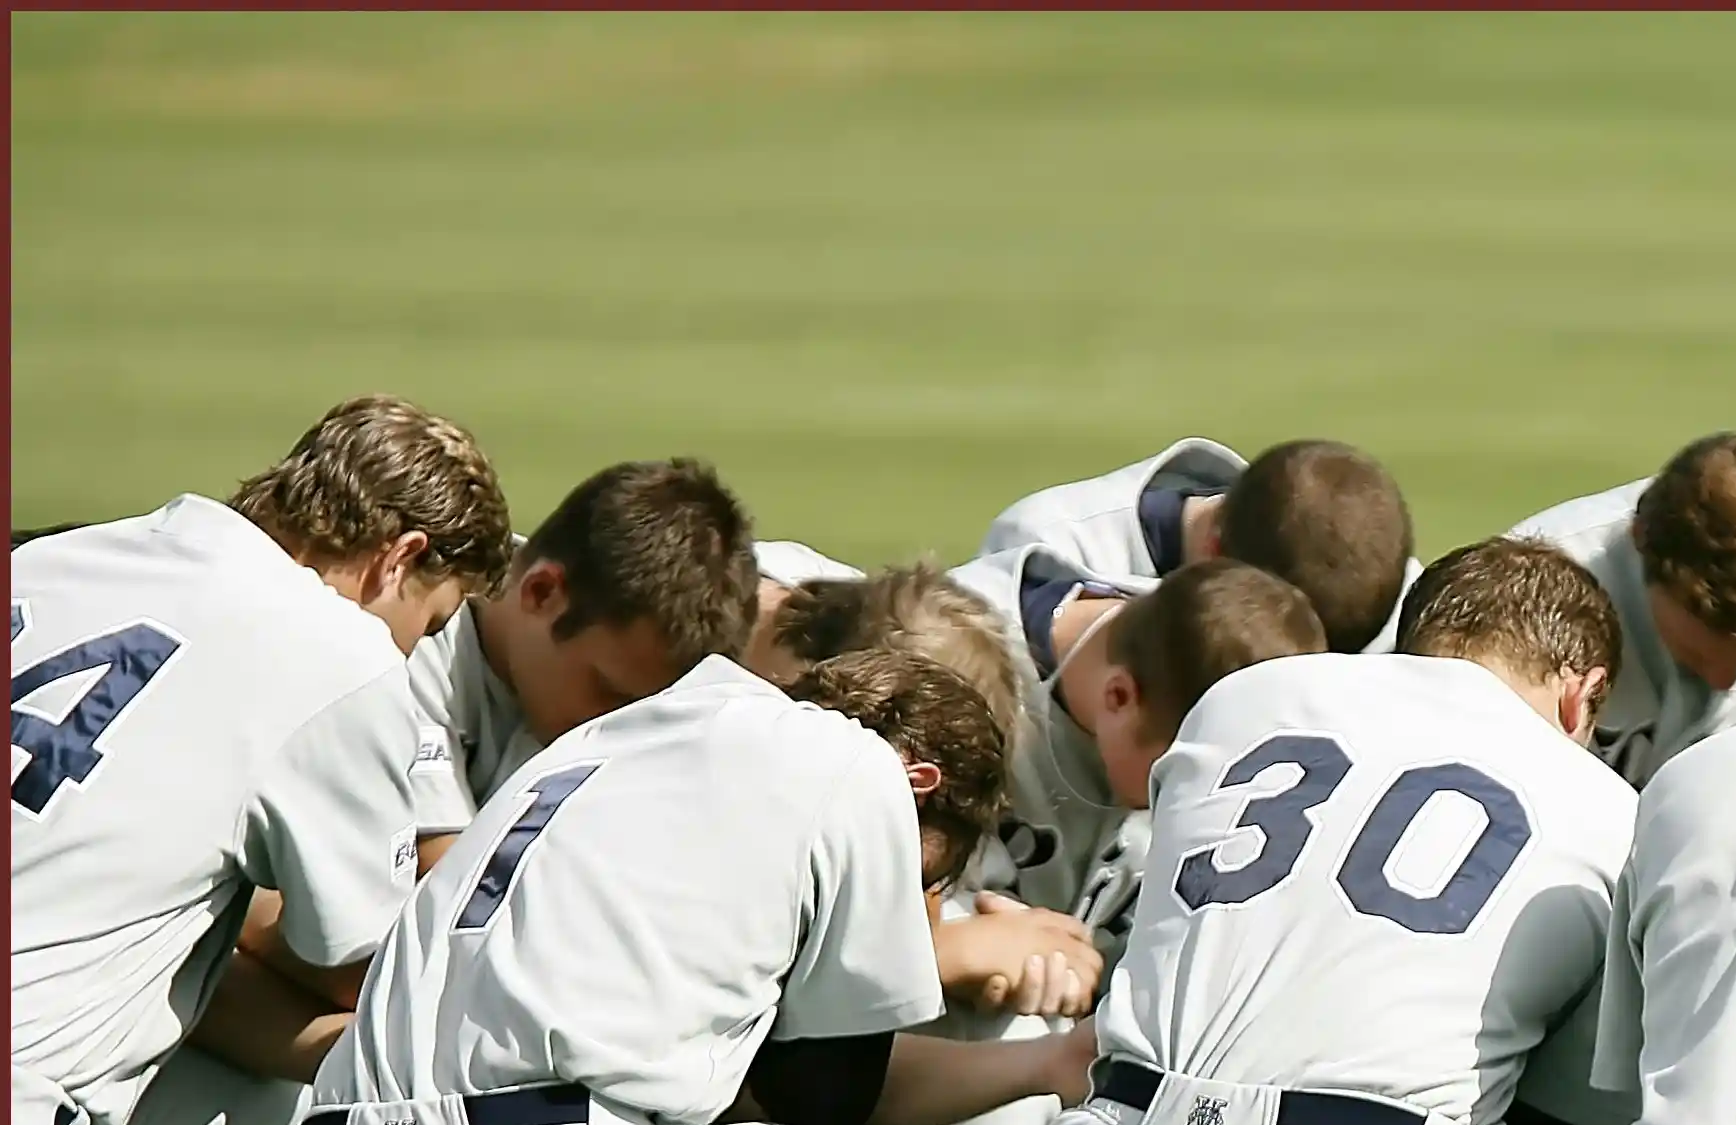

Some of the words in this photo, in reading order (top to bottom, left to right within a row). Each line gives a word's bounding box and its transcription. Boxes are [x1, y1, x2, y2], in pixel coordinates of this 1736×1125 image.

[11, 600, 187, 819] 4
[452, 758, 606, 934] 1
[1176, 730, 1533, 936] 30
